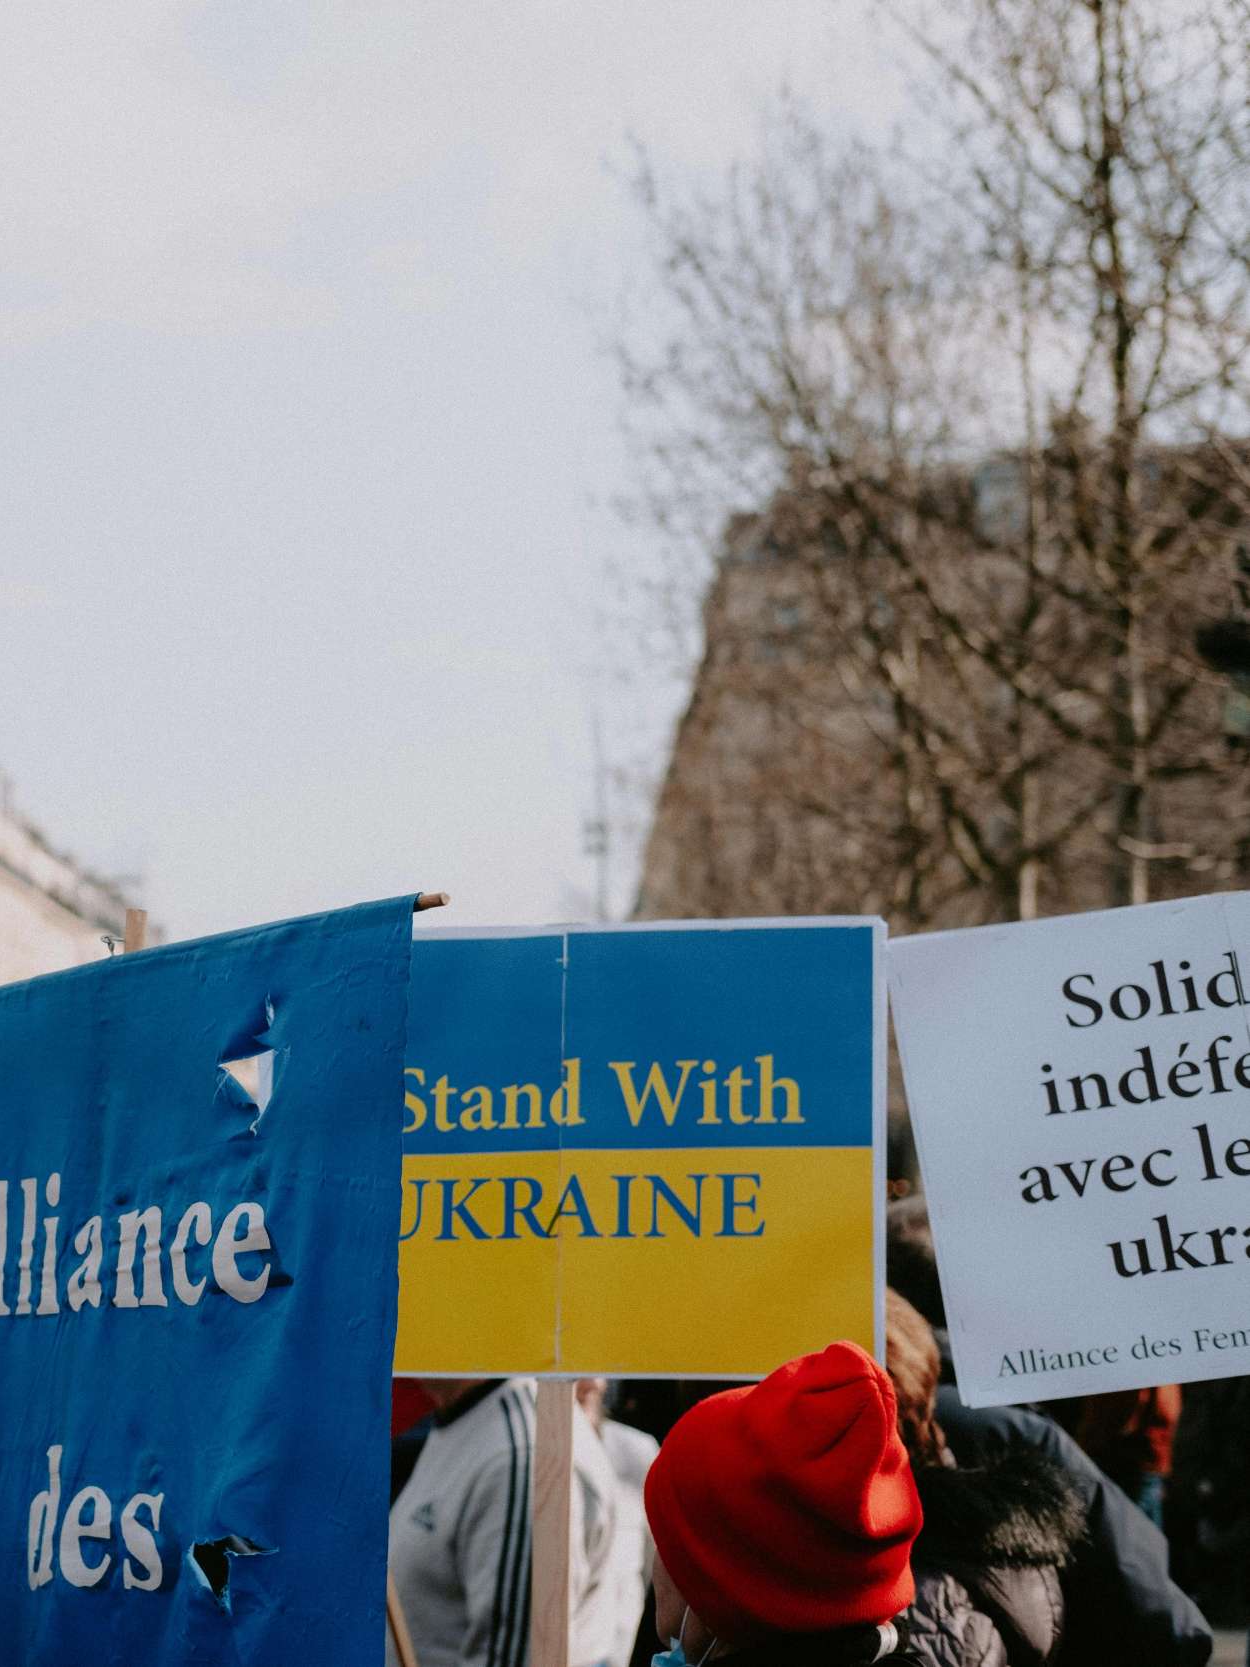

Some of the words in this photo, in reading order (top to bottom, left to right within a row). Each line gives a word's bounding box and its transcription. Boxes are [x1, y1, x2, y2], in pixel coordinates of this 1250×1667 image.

[1062, 951, 1250, 1028] Solid
[608, 1054, 805, 1127] With
[1019, 1147, 1177, 1204] avec
[1106, 1213, 1250, 1278] ukr
[997, 1344, 1118, 1378] Alliance
[1131, 1335, 1182, 1360] des
[27, 1444, 165, 1592] des
